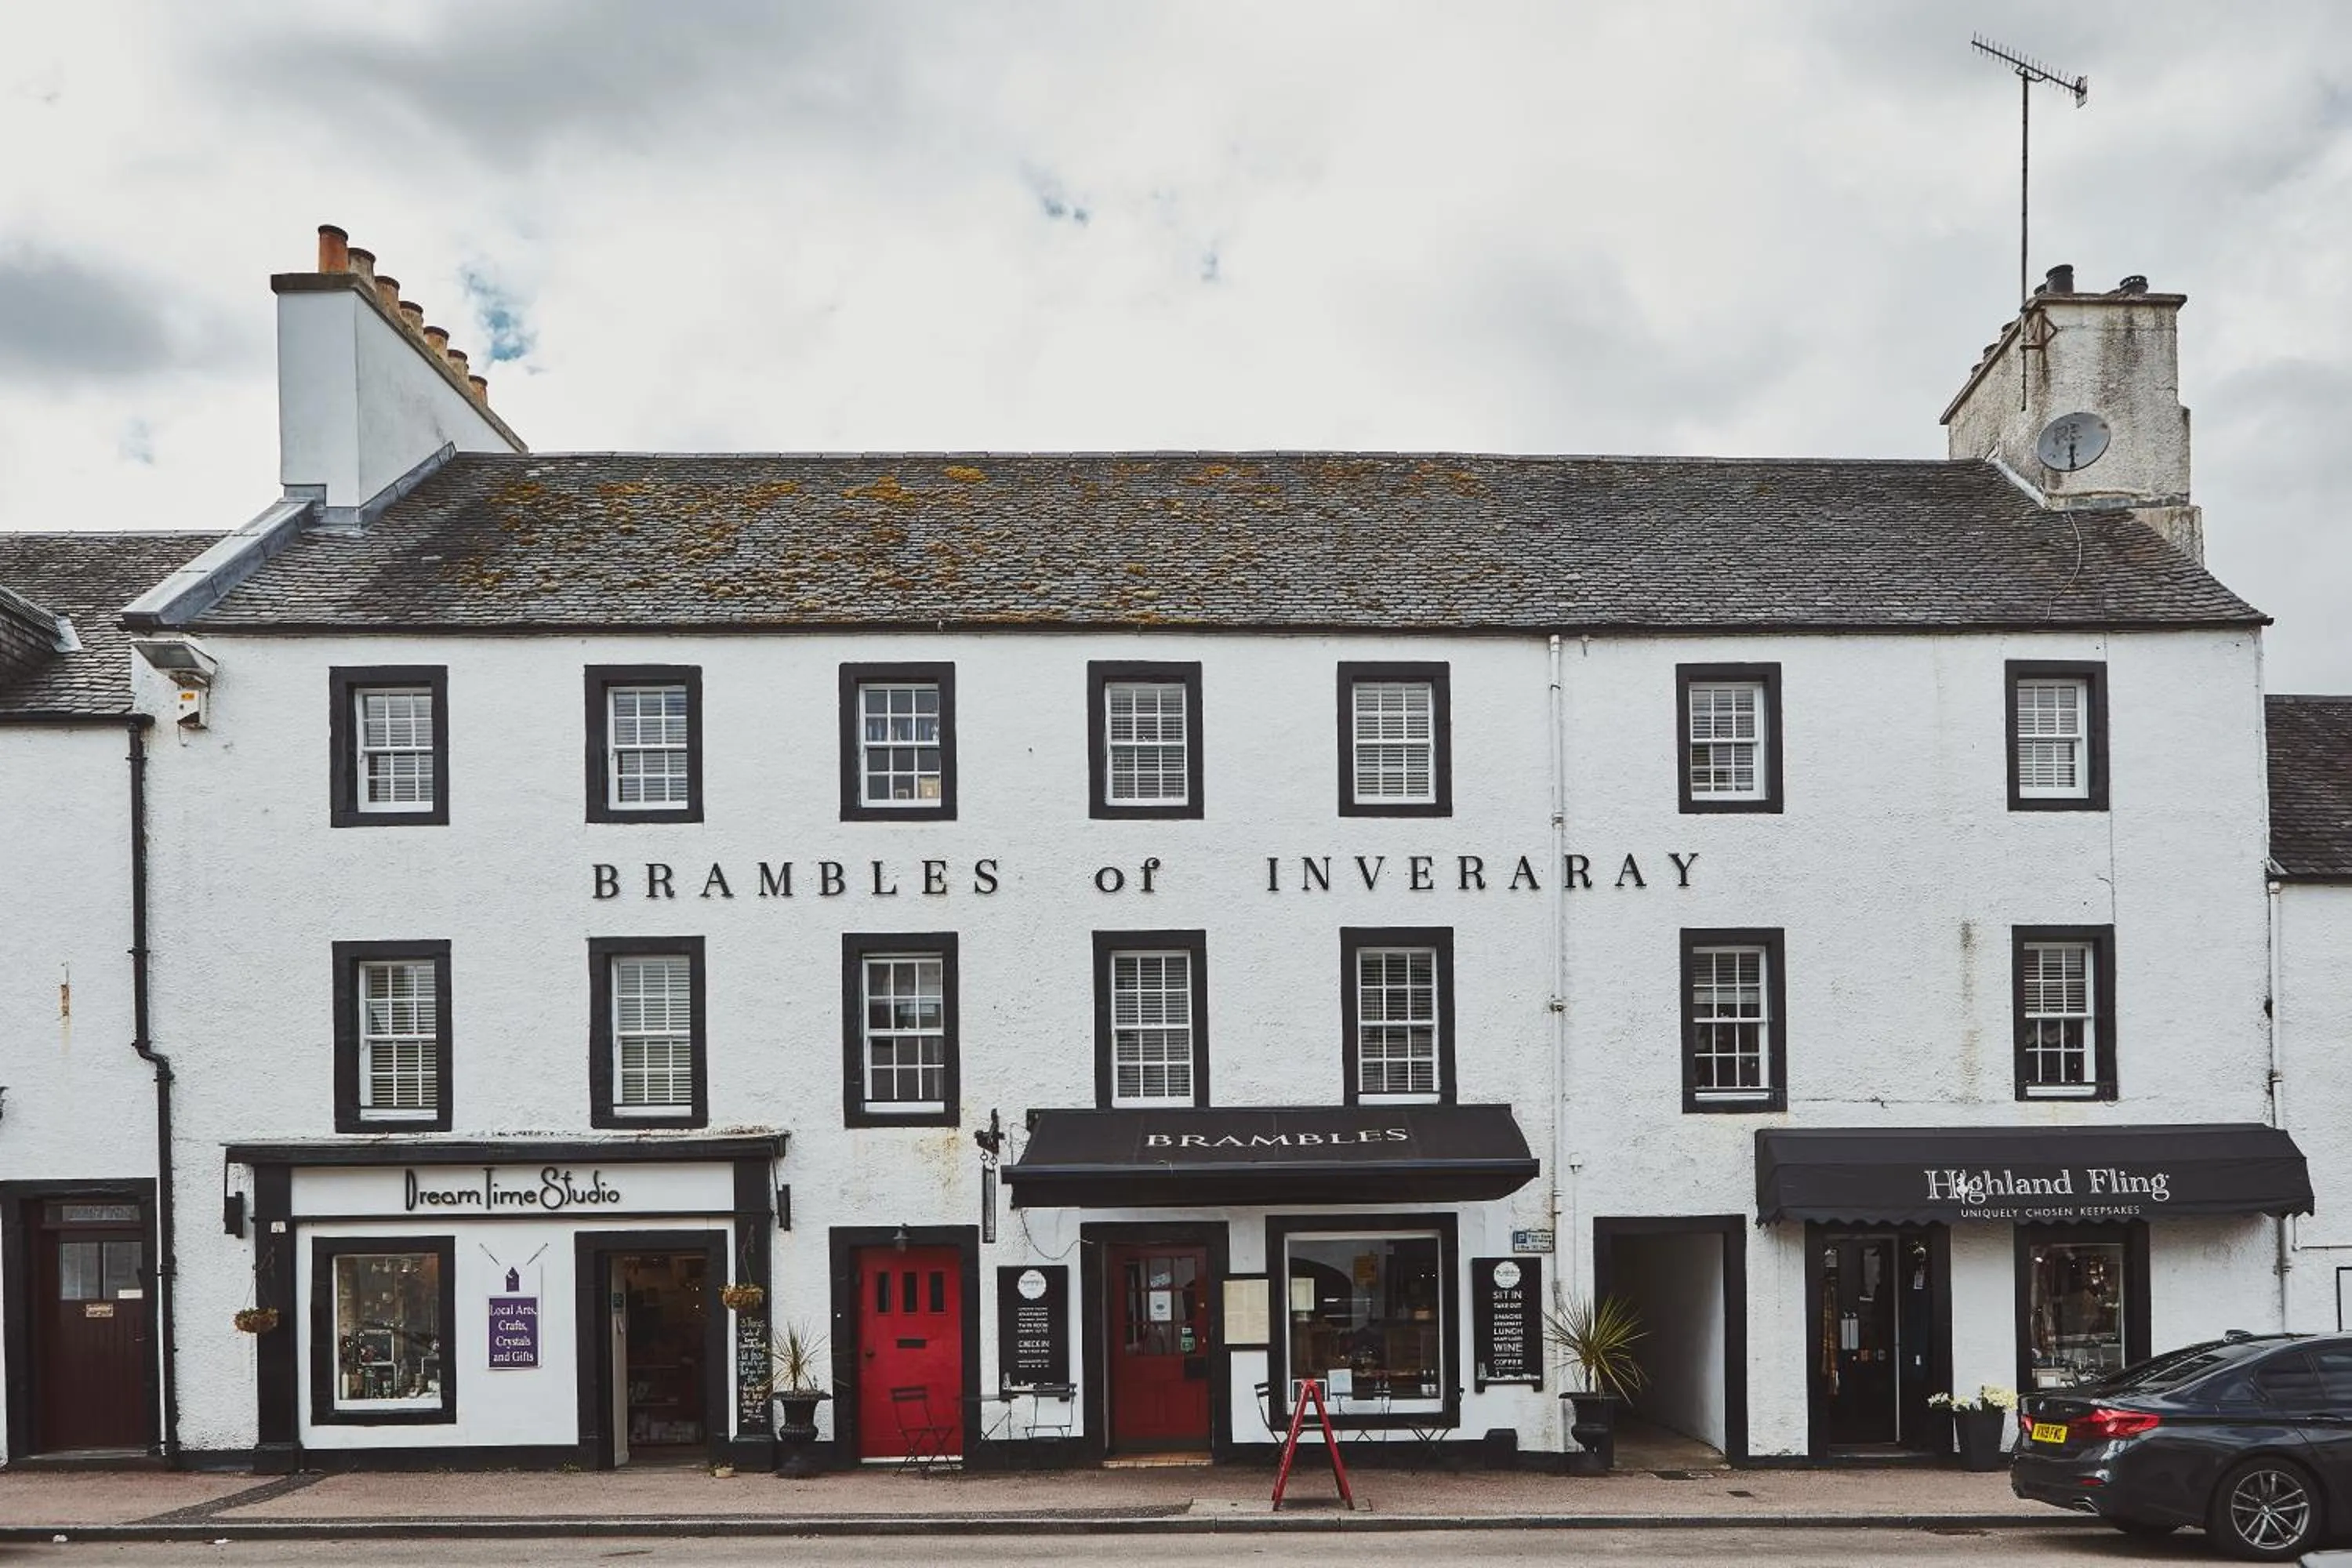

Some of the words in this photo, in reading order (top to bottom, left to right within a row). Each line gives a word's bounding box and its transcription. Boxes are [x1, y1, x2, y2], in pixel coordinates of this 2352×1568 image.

[592, 859, 999, 899] BRAMBLES
[1094, 858, 1161, 894] of
[1266, 853, 1699, 892] INVERARAY
[1146, 1127, 1409, 1148] BRAMBLES
[1924, 1168, 2074, 1205] Highland
[2086, 1167, 2170, 1202] Fling
[1961, 1208, 2019, 1219] UNIQUELY
[2025, 1207, 2074, 1217] CHOSEN
[2080, 1205, 2140, 1216] KEEPSAKES
[1493, 1290, 1508, 1299] SIT
[1511, 1290, 1523, 1299] IN
[489, 1304, 514, 1316] Local
[495, 1335, 532, 1349] Crystals
[1494, 1342, 1523, 1352] WINE
[493, 1351, 510, 1362] and
[512, 1351, 535, 1362] Gifts
